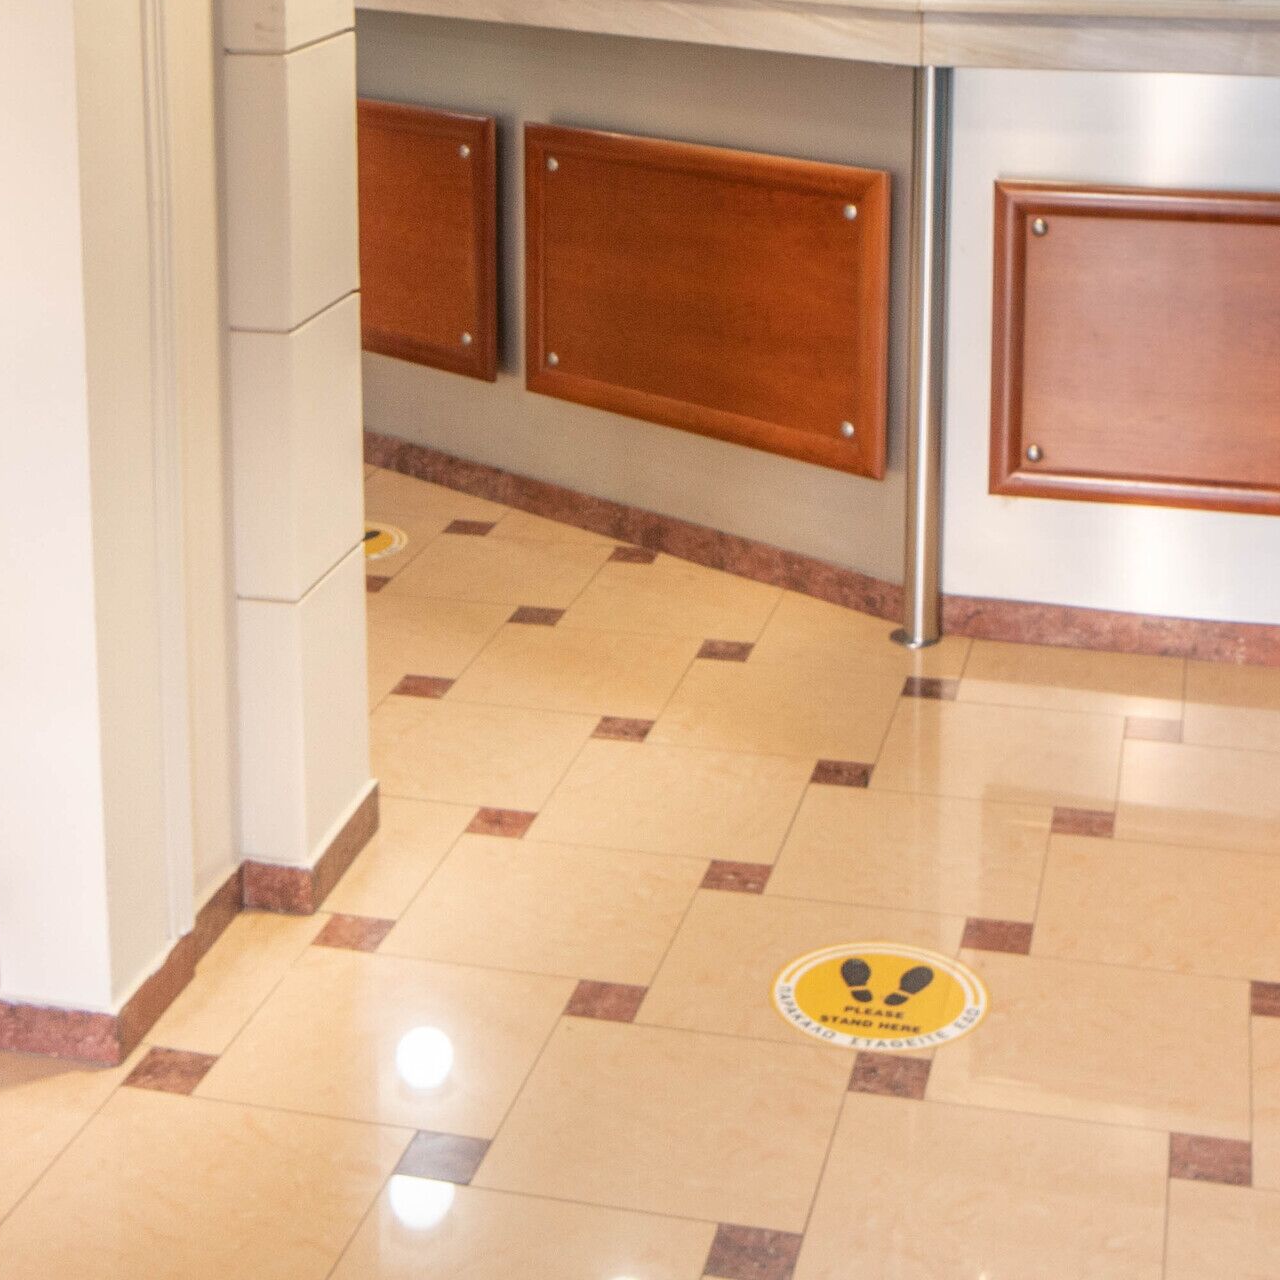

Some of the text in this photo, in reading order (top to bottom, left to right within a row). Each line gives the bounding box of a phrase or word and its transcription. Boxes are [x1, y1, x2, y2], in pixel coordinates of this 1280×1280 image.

[844, 1005, 905, 1019] PLEASE
[820, 1015, 922, 1034] STAND HERE
